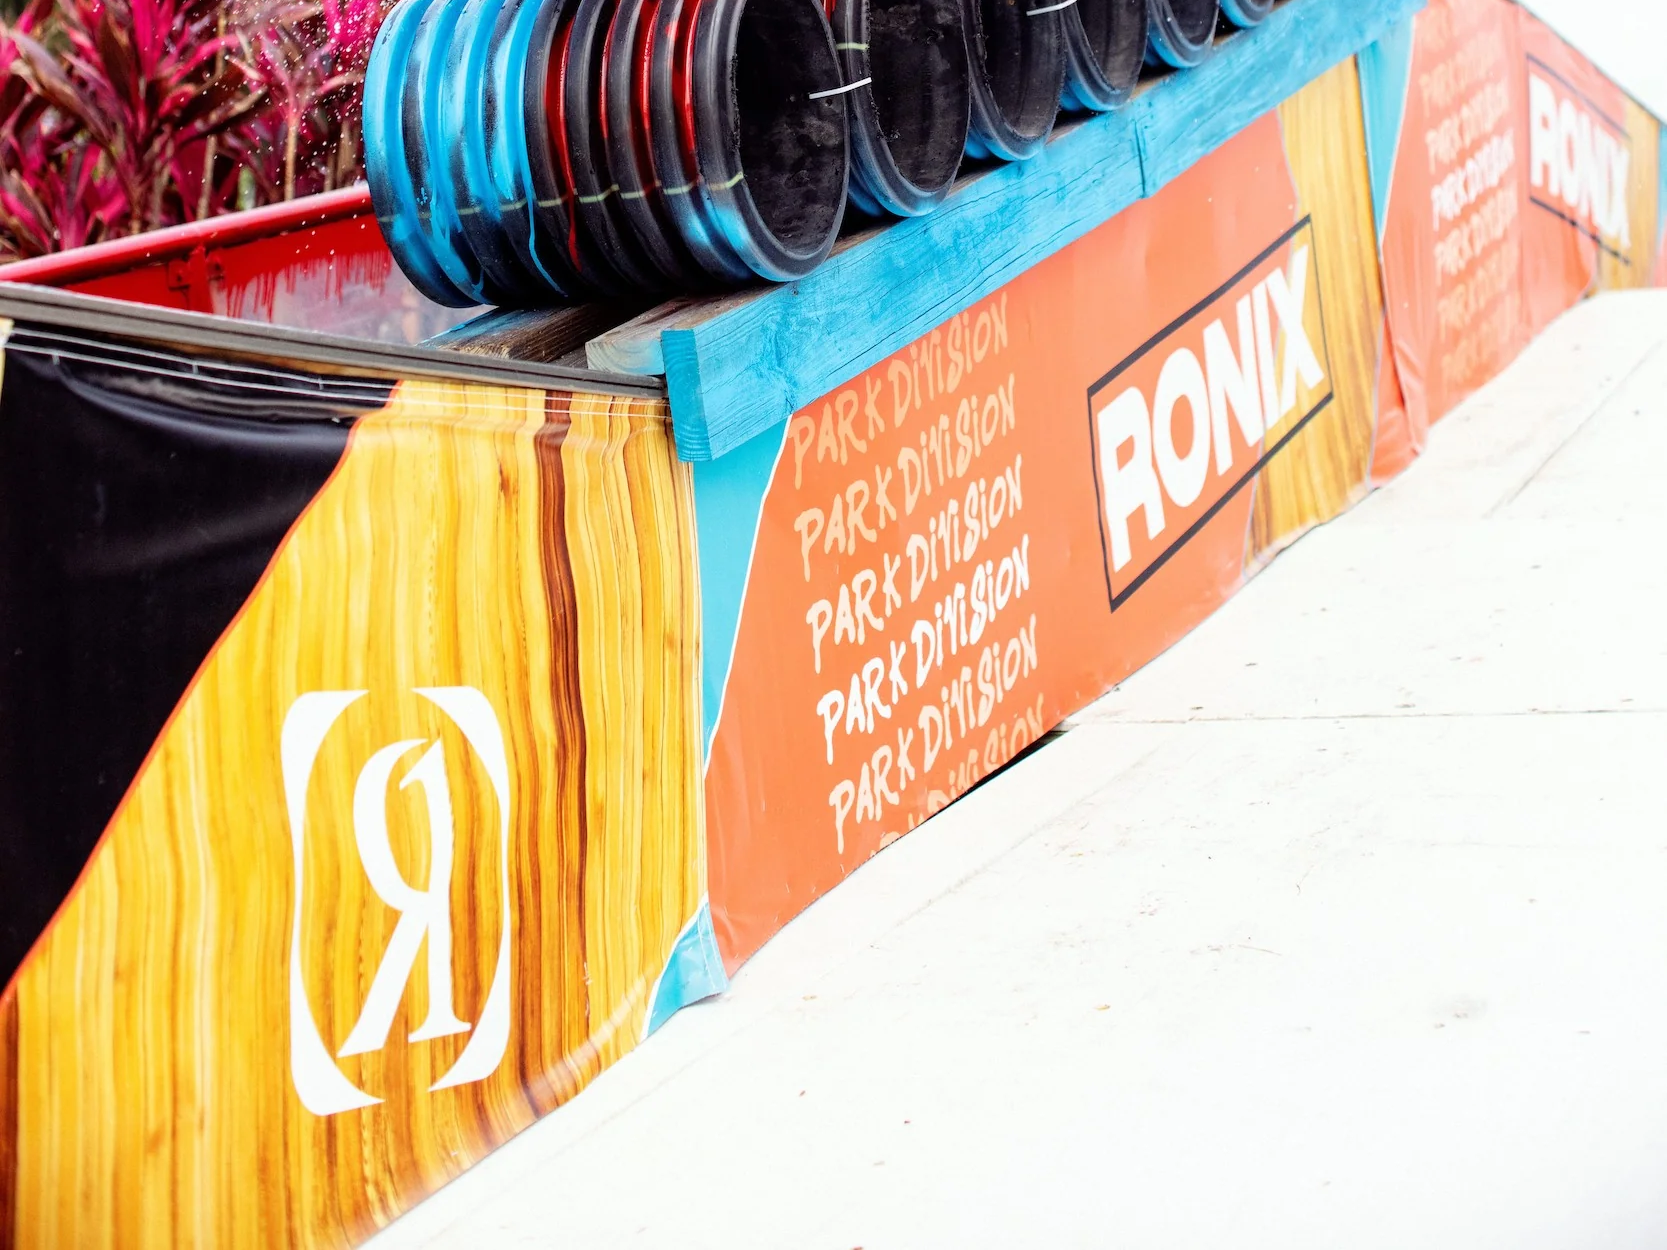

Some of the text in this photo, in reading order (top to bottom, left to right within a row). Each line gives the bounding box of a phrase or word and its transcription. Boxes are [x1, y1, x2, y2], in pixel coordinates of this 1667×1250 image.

[1530, 75, 1631, 247] RONIX
[788, 375, 885, 490] PARK
[1097, 245, 1325, 573] RONIX
[794, 464, 896, 581] PARK
[806, 553, 902, 673] PARK
[816, 640, 908, 765] PARK
[829, 726, 915, 854] PARK
